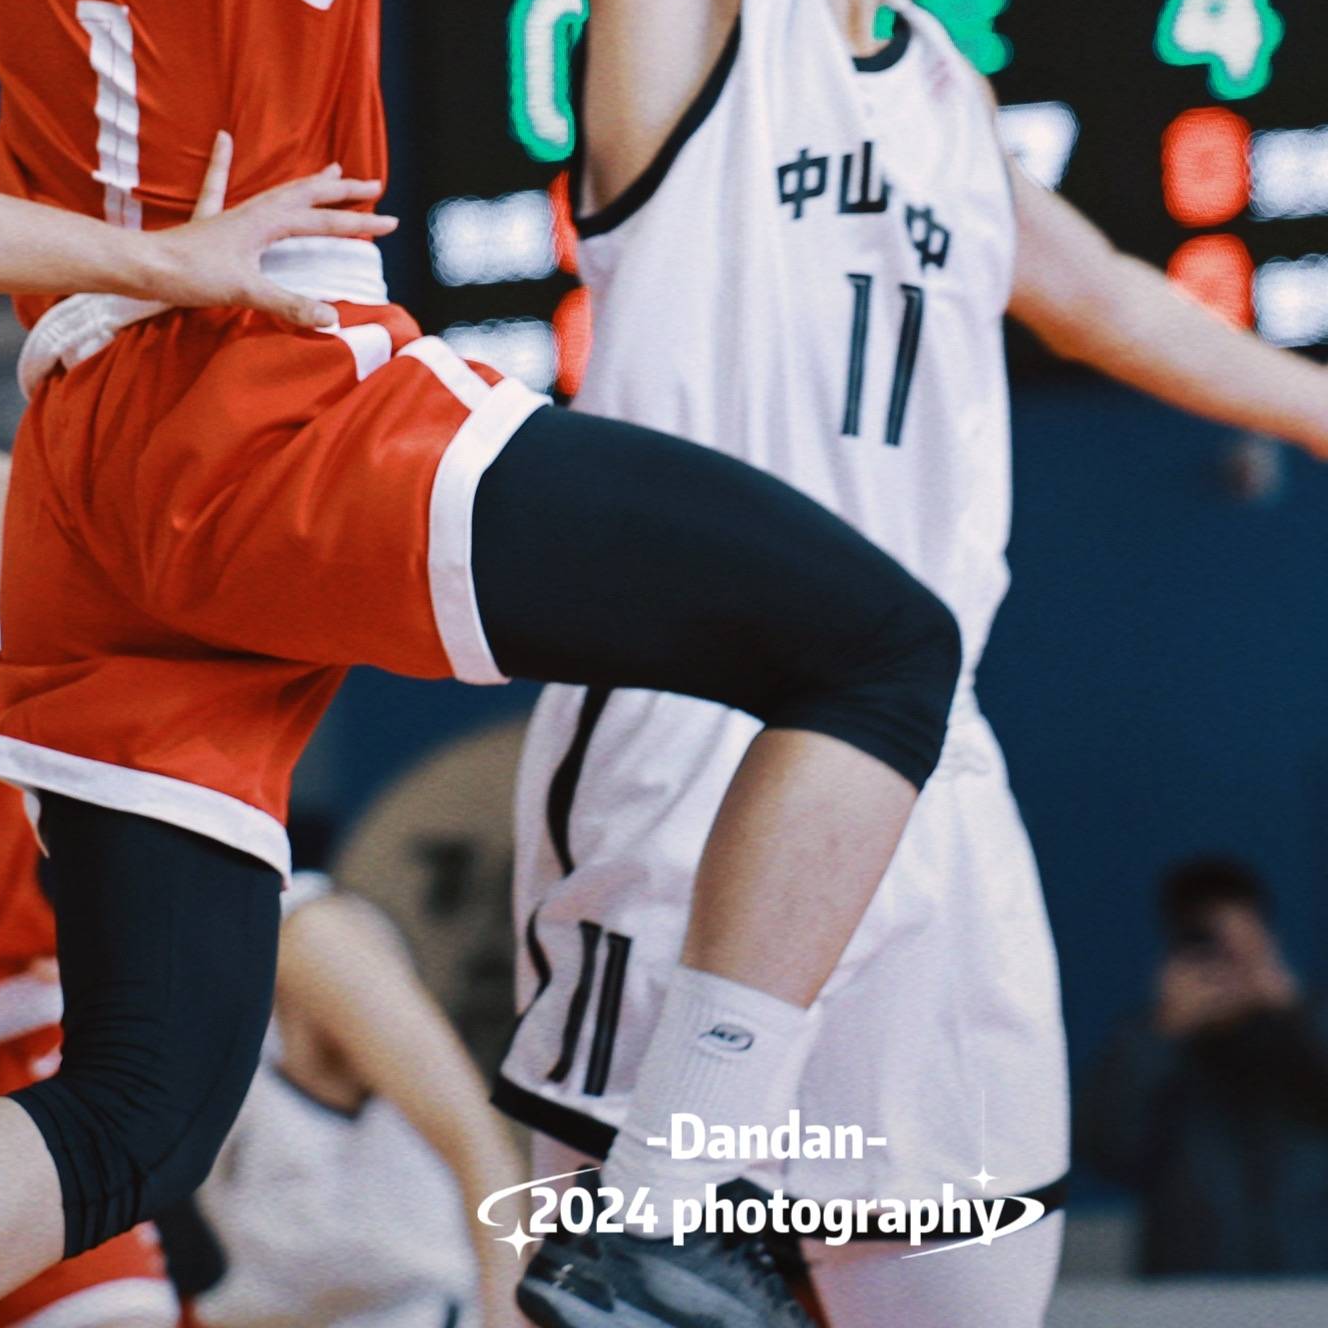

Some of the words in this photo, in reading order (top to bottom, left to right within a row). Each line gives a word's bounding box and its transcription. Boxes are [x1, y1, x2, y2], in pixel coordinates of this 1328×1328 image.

[777, 139, 953, 275] 中山中
[840, 272, 926, 448] 11
[546, 919, 634, 1098] 11
